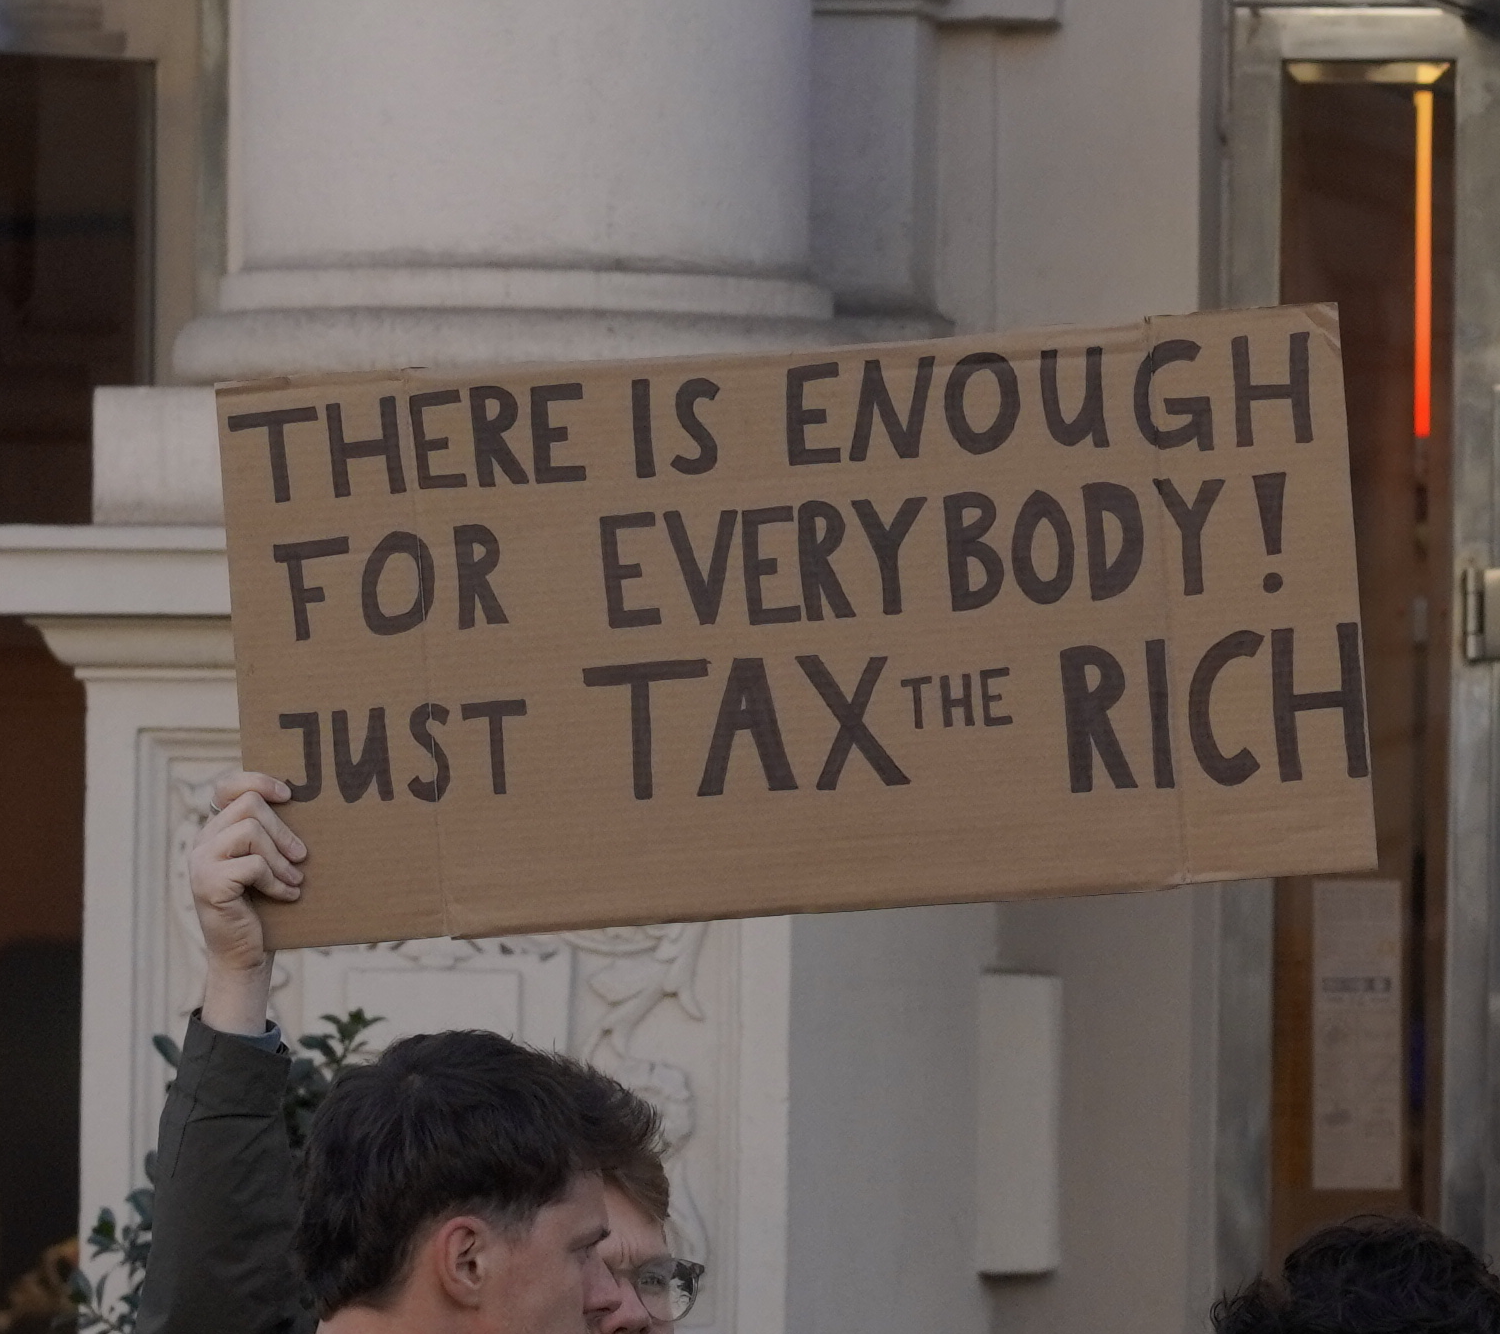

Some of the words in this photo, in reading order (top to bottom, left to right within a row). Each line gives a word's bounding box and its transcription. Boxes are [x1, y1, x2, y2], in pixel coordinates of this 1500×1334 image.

[228, 383, 587, 503] THERE
[631, 378, 720, 478] IS
[786, 332, 1314, 466] ENOUGH
[273, 524, 510, 642] FOR
[600, 472, 1286, 629] EVERYBODY!
[279, 699, 527, 804] JUST
[583, 655, 911, 800] TAX
[901, 667, 1013, 729] THE
[1060, 622, 1368, 793] RICH
